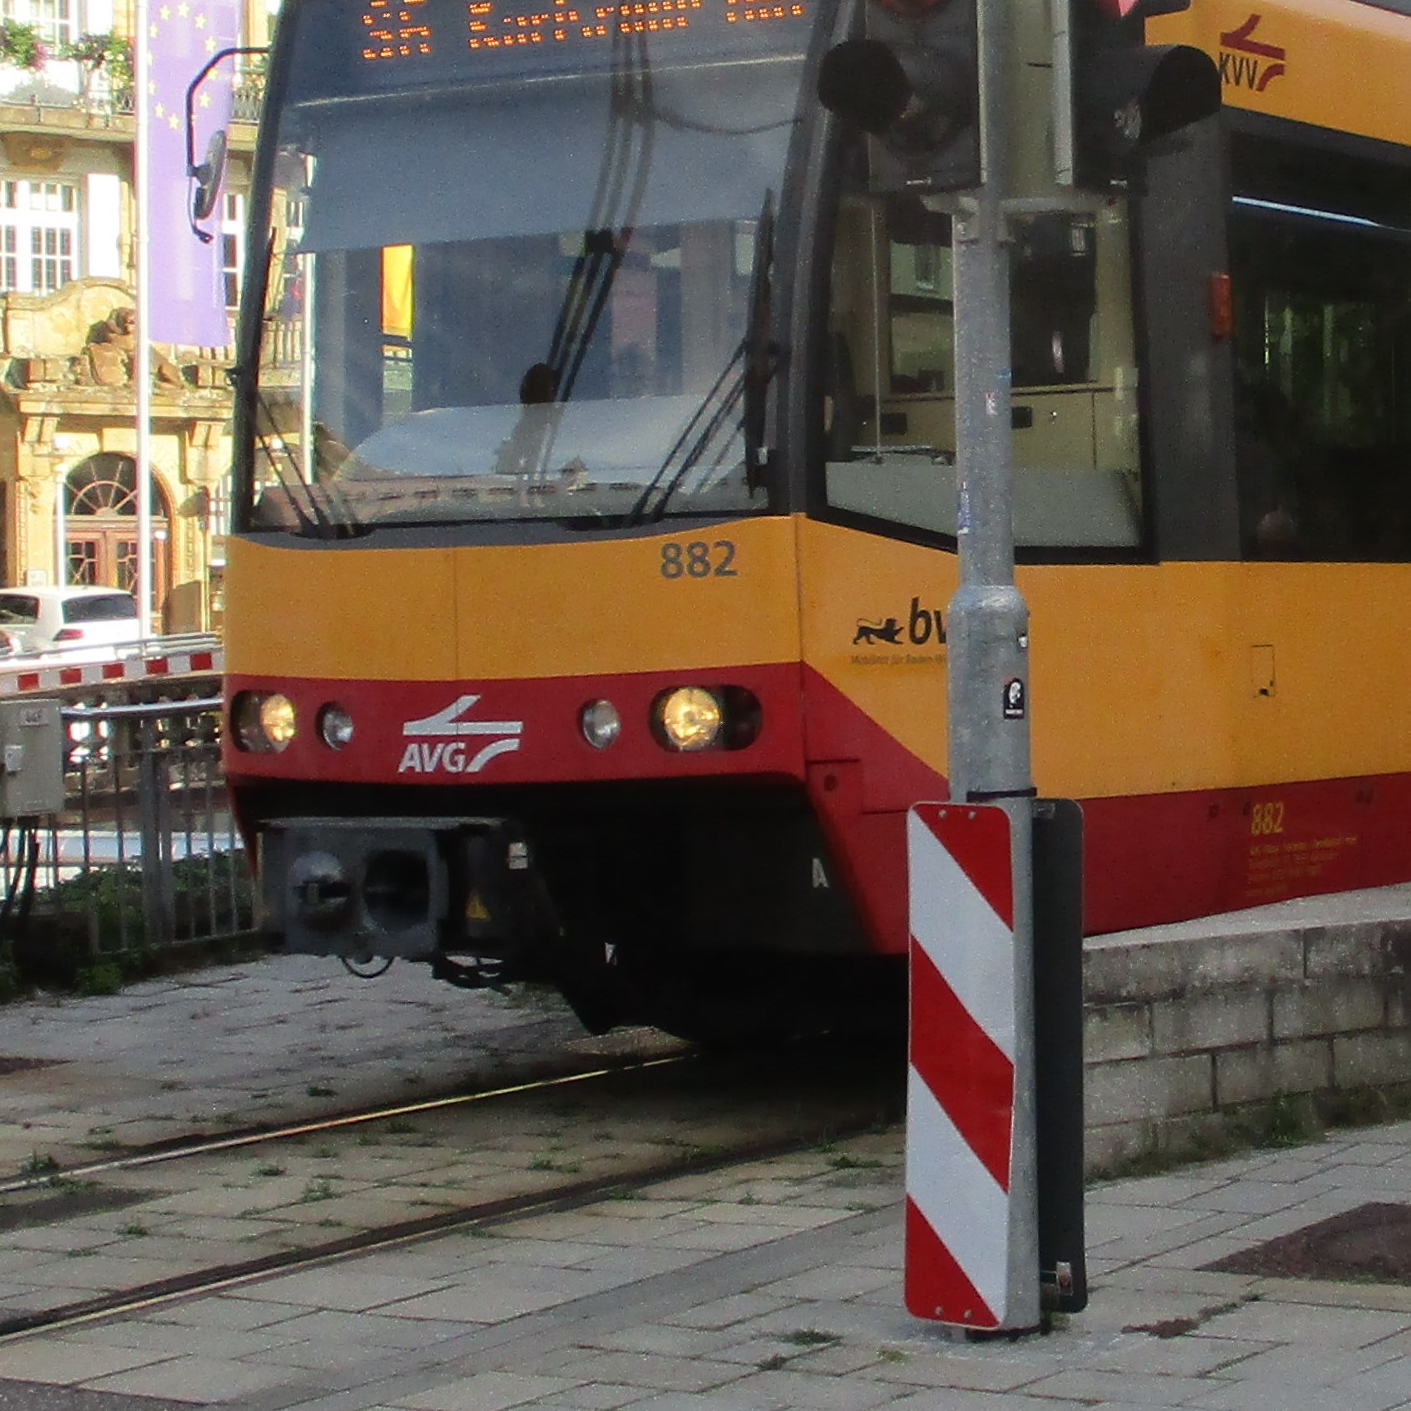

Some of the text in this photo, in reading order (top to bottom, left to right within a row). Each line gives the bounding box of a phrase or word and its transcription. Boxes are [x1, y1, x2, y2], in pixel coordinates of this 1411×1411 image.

[1218, 51, 1259, 90] KVV
[660, 540, 739, 579] 882
[397, 741, 467, 774] AVG
[1250, 801, 1285, 836] 882
